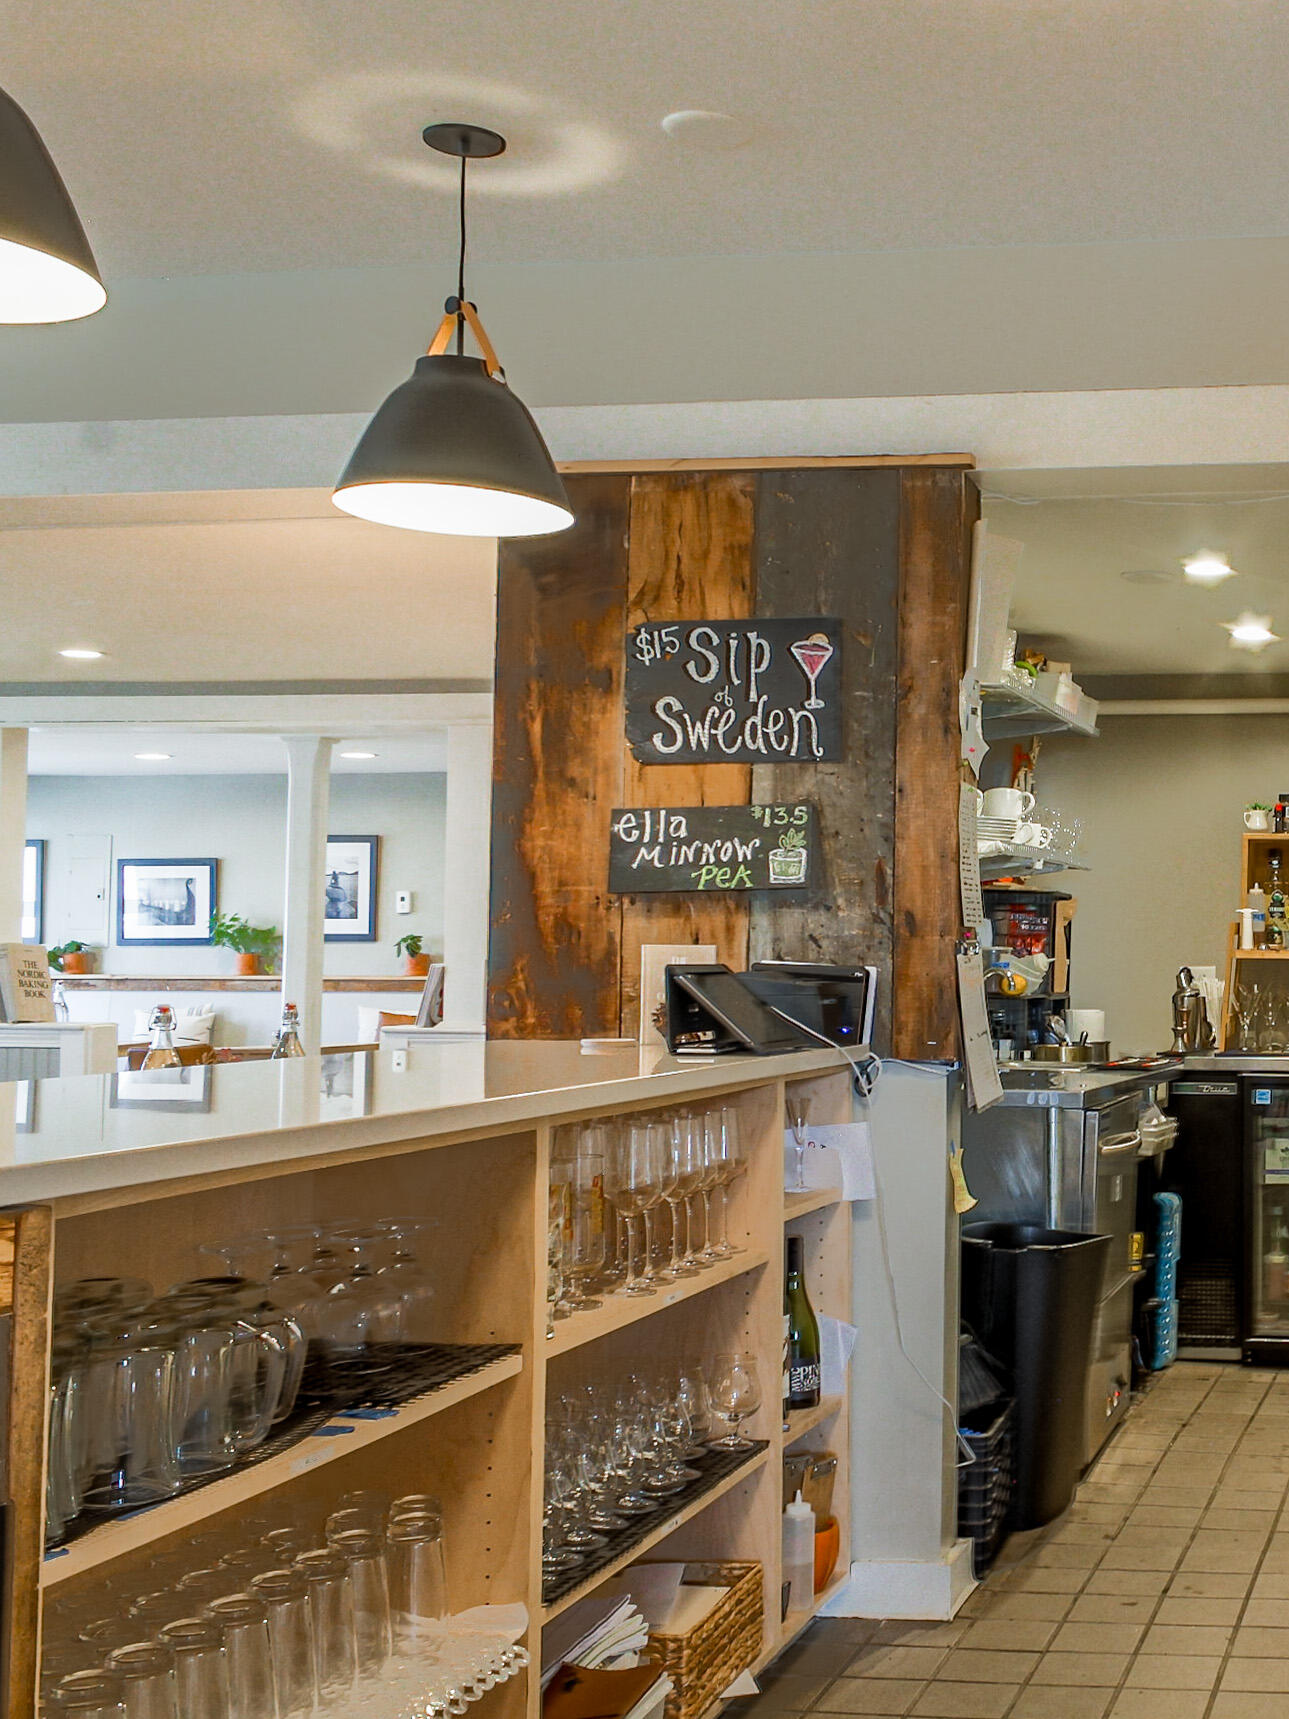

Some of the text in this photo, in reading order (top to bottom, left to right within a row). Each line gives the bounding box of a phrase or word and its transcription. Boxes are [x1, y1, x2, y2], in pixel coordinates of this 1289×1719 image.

[636, 626, 680, 666] $15
[686, 626, 771, 702] Sip
[714, 685, 733, 706] of
[652, 694, 824, 757] Sweden
[615, 810, 688, 843] ella
[751, 806, 808, 828] $13.5
[17, 969, 47, 979] NORDIC
[22, 959, 39, 969] THE
[18, 979, 49, 989] BAKING
[24, 990, 47, 999] BOOK
